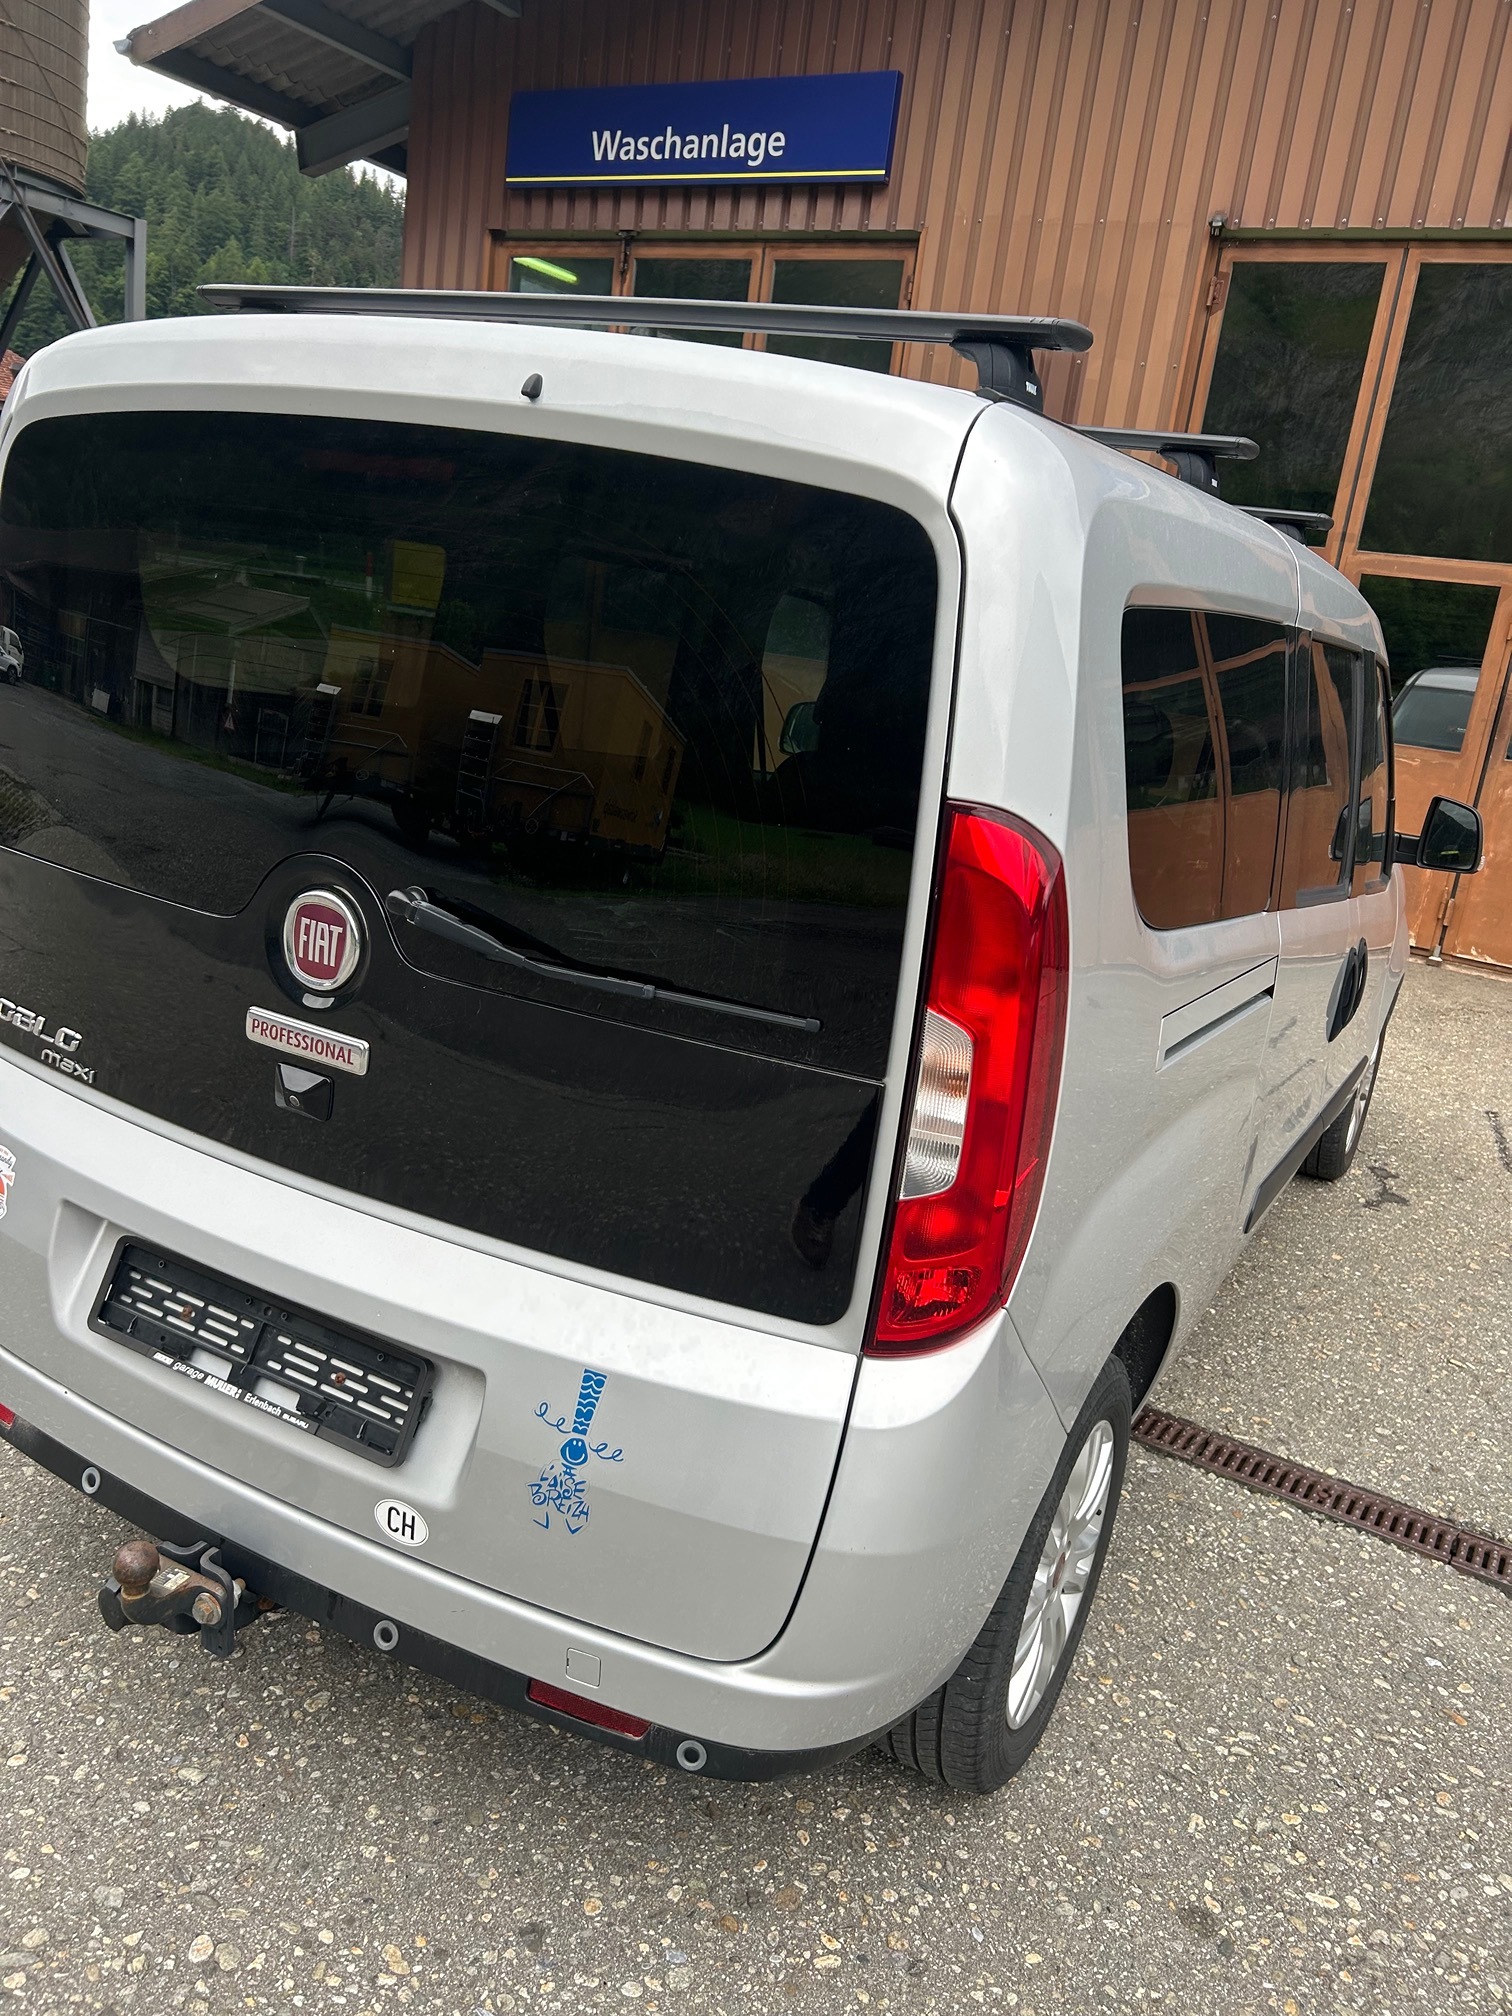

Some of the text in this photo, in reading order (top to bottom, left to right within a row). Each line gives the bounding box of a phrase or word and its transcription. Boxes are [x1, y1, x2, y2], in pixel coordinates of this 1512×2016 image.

[592, 124, 786, 167] Waschanlage
[298, 916, 344, 968] FIAT
[251, 1018, 355, 1066] PROFESSIONAL
[41, 1049, 95, 1084] maxi
[172, 1361, 205, 1380] garage
[244, 1392, 282, 1417] Erlenbach
[387, 1506, 416, 1541] CH
[528, 1483, 590, 1523] BREIZH
